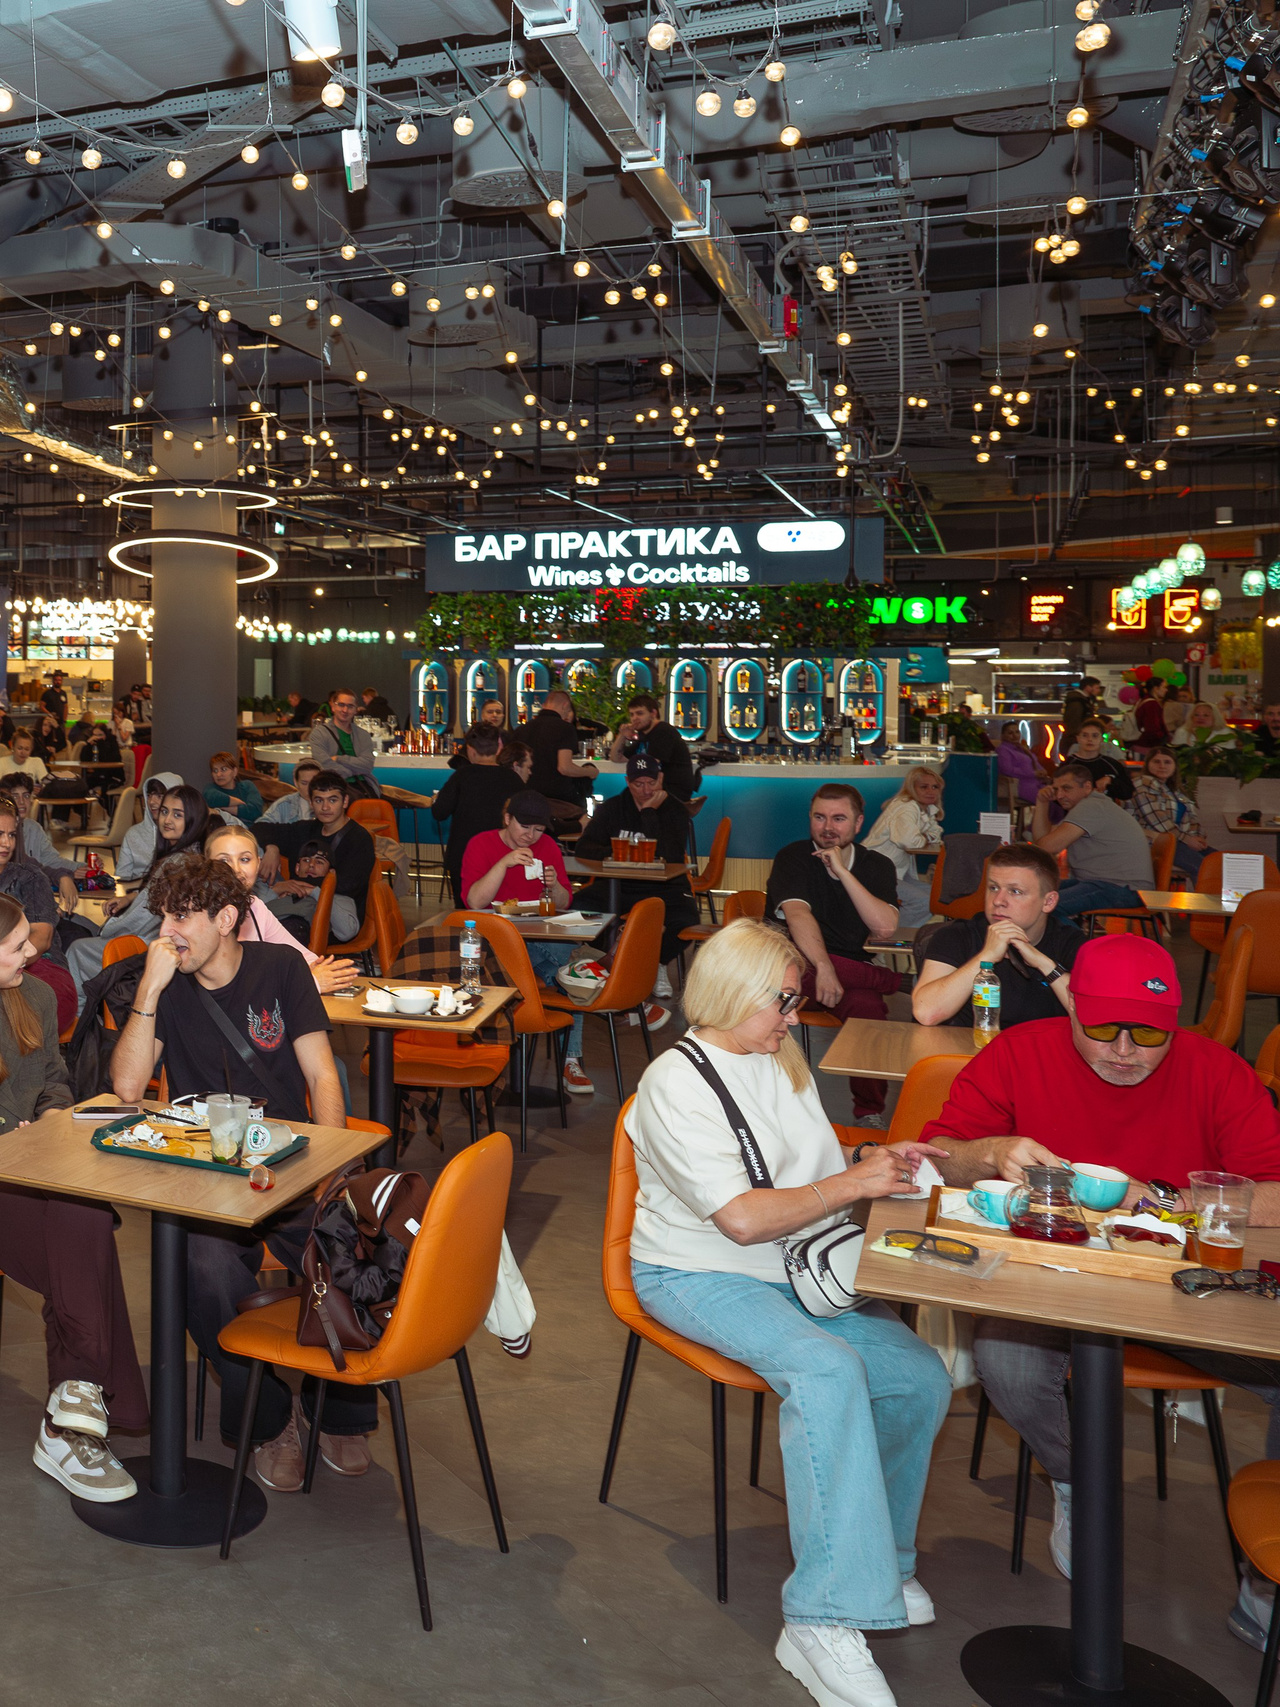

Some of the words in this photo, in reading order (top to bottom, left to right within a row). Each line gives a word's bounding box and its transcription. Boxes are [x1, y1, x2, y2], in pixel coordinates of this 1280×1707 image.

[454, 534, 527, 562] БАР
[534, 526, 741, 559] ПРАКТИКА
[527, 565, 603, 587] Wines
[627, 561, 750, 584] Cocktails
[868, 596, 968, 624] WOK
